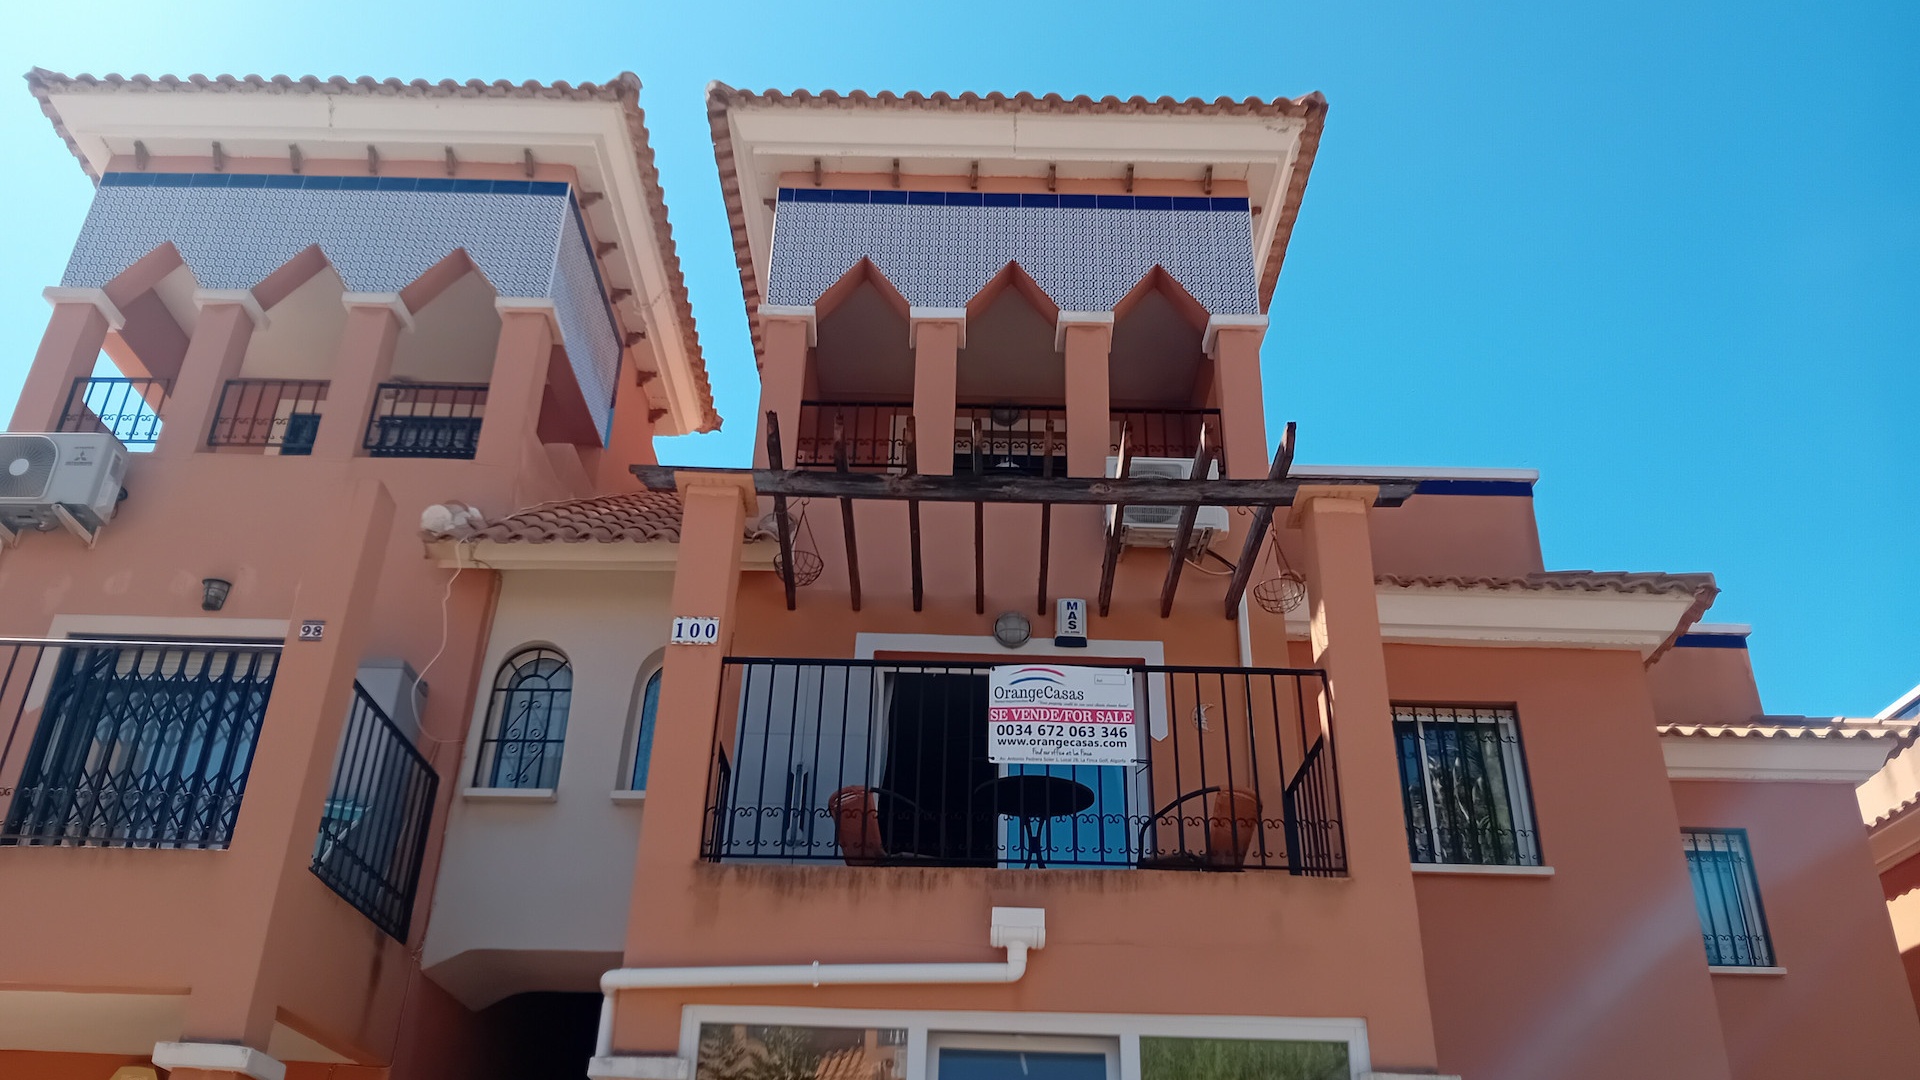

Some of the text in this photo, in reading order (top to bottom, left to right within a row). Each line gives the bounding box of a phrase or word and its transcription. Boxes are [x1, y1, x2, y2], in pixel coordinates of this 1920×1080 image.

[1066, 601, 1077, 630] MAS
[301, 625, 323, 636] 98
[675, 622, 716, 639] 100
[994, 685, 1084, 702] OrangeCasas
[990, 709, 1132, 723] SE VENDE/FOR SALE
[996, 724, 1128, 738] 0034 672 063 346
[997, 737, 1127, 748] www.orangecasas.com
